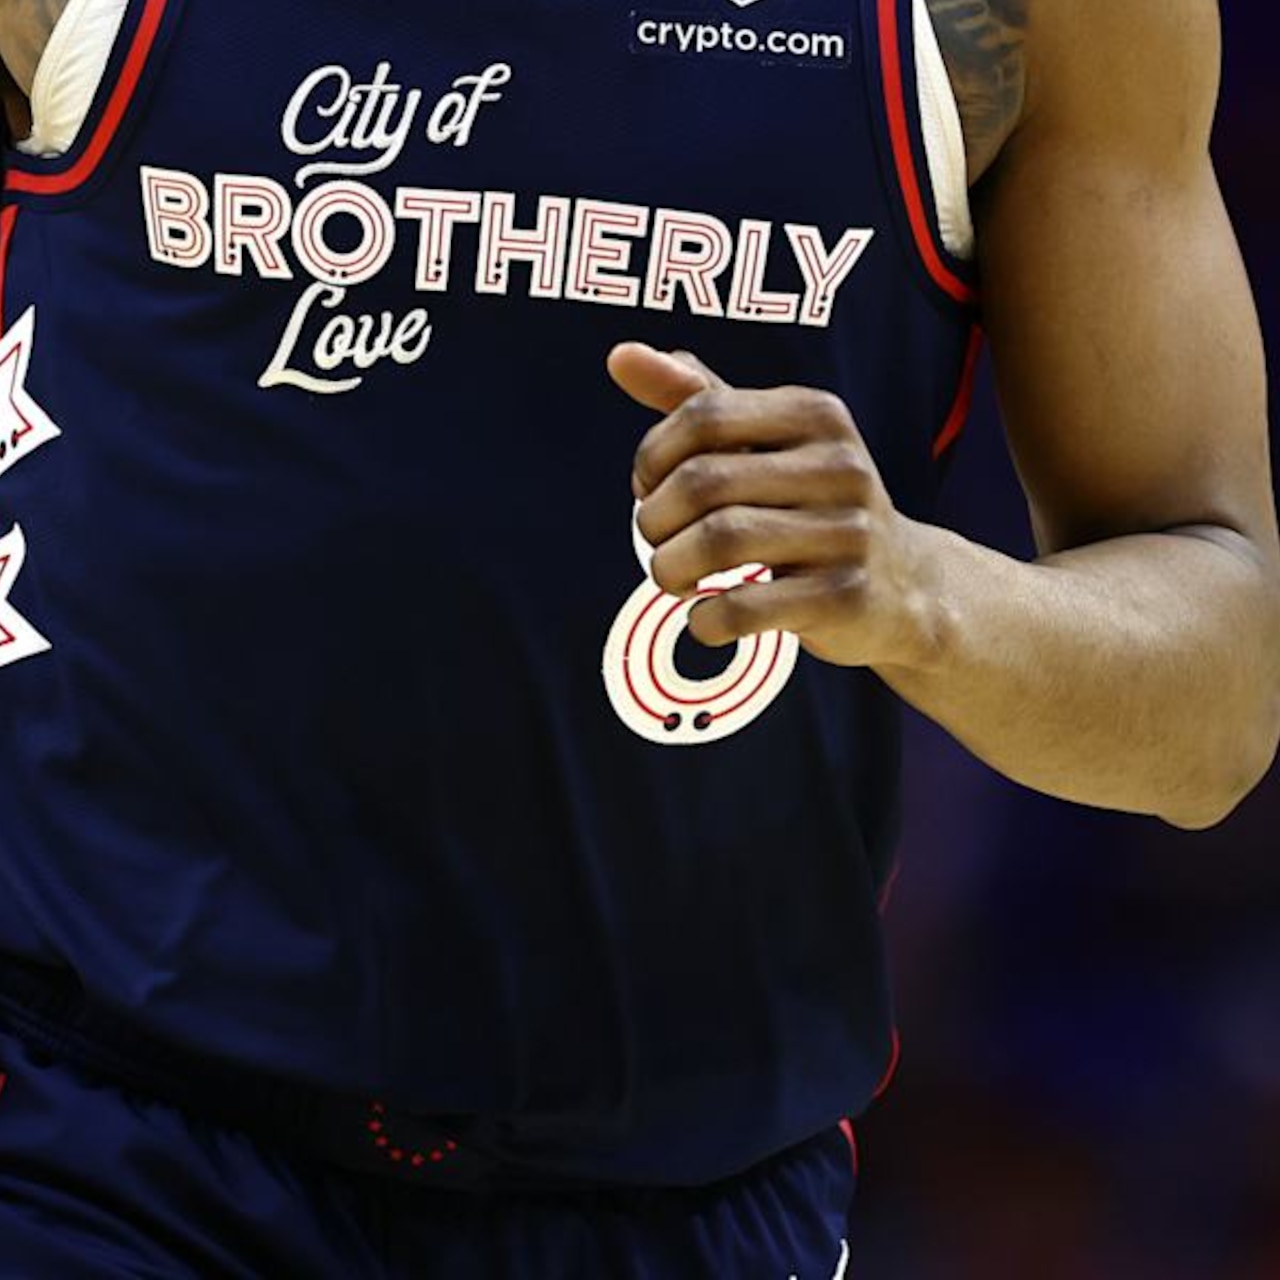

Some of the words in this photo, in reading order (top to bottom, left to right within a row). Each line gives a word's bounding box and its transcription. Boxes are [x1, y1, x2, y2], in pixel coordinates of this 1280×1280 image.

[636, 16, 845, 59] crypto.com
[280, 61, 422, 190] City
[426, 61, 513, 148] of
[139, 165, 876, 328] BROTHERLY
[257, 282, 432, 395] Love
